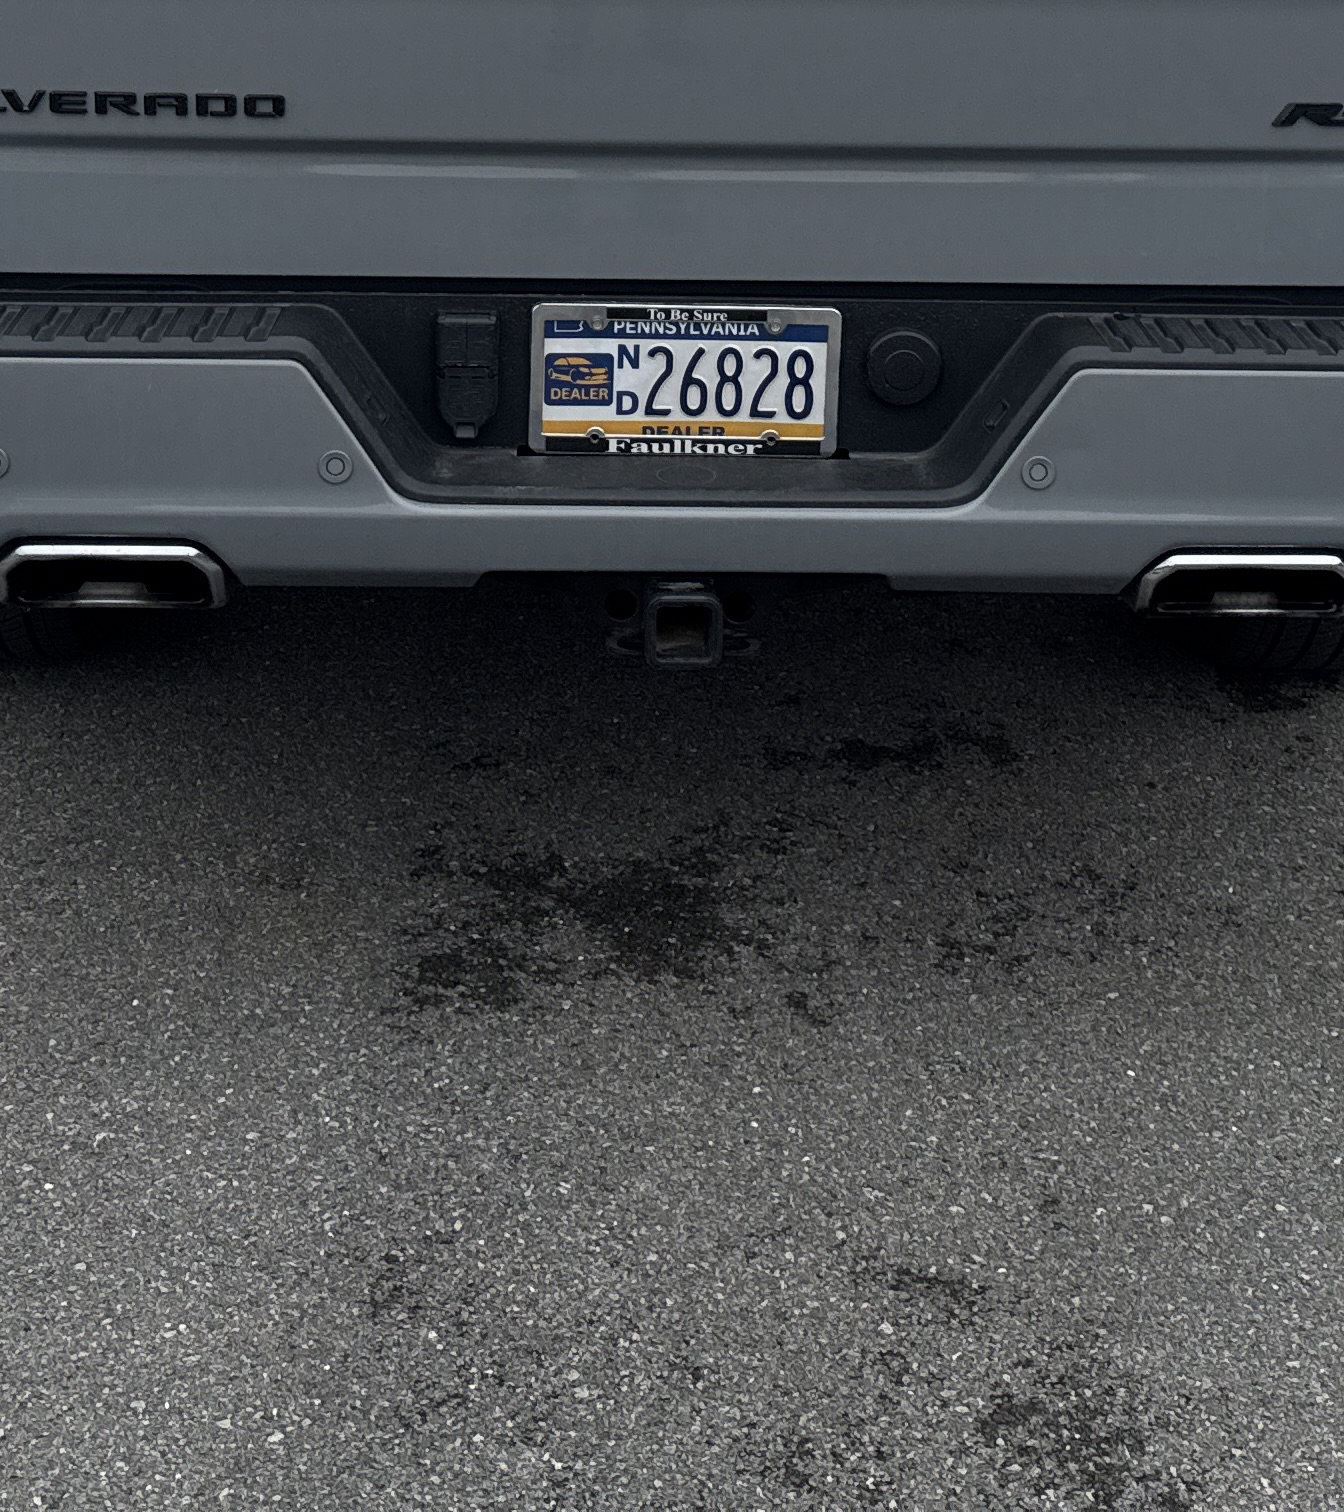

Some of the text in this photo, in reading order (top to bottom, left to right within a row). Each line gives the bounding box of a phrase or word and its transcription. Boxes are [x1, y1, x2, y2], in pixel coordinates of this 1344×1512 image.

[647, 309, 728, 322] To Be Sure
[613, 321, 760, 336] PENNSYLVANIA
[644, 345, 815, 420] 26828
[550, 388, 609, 400] DEALER
[641, 426, 725, 436] DEALER
[607, 439, 763, 455] Faulkner
